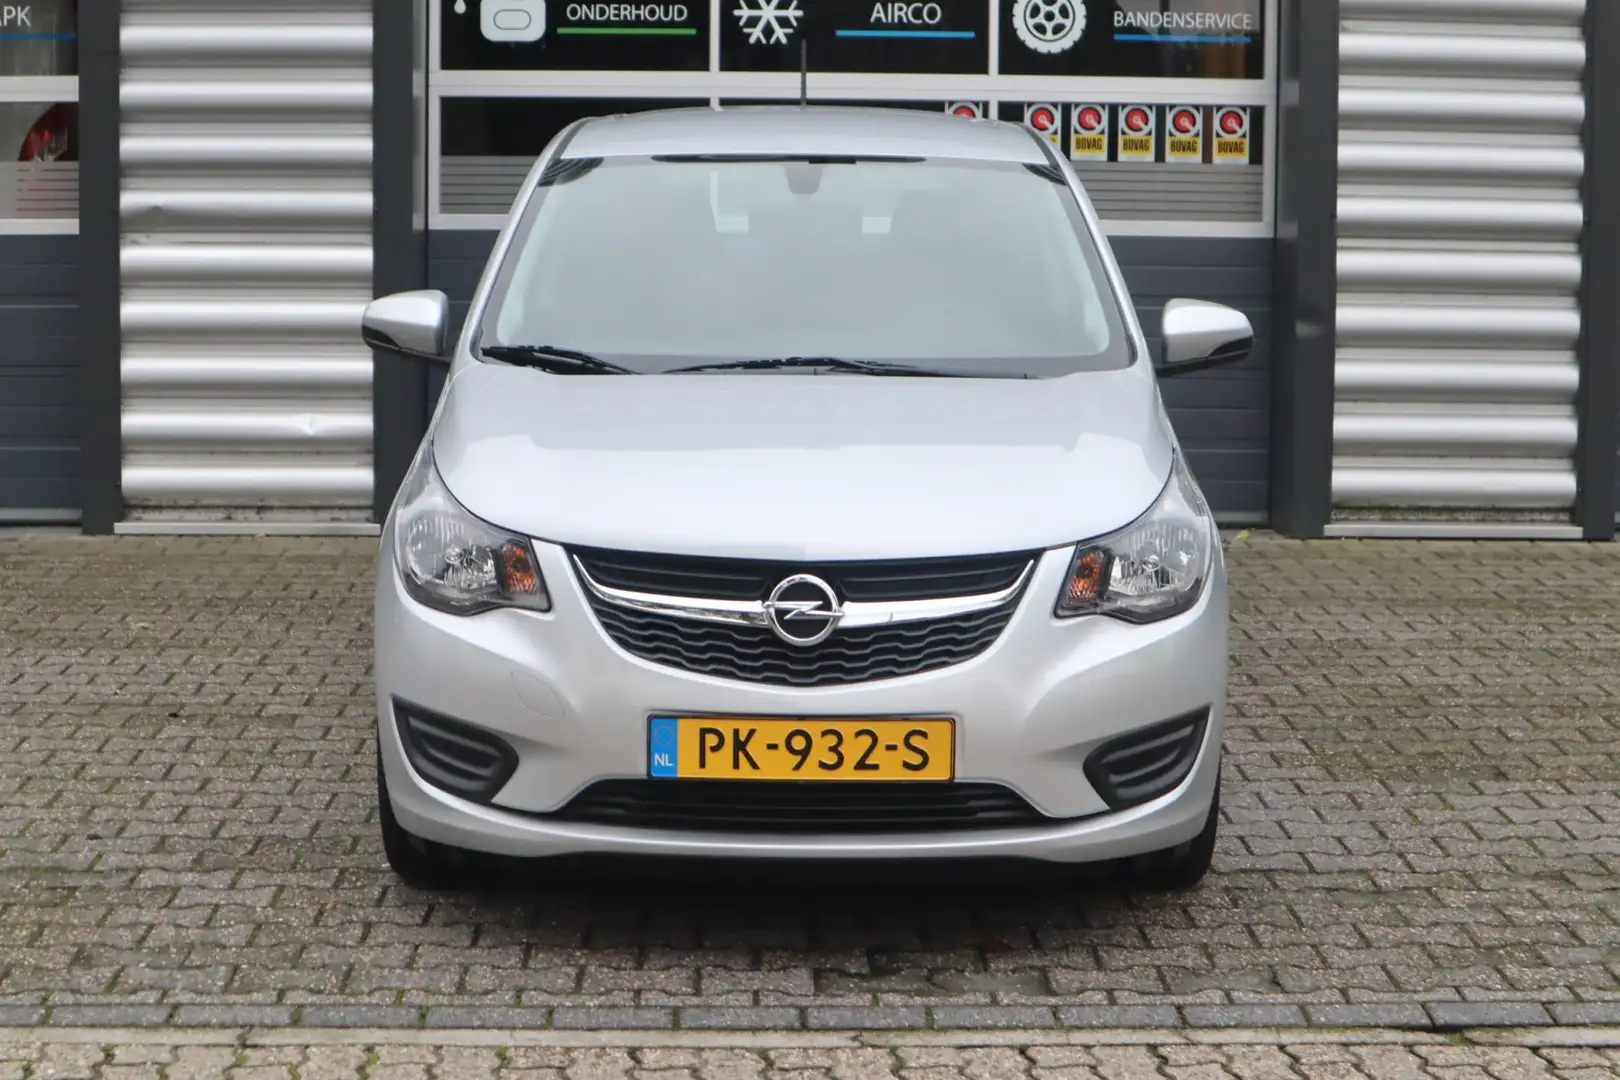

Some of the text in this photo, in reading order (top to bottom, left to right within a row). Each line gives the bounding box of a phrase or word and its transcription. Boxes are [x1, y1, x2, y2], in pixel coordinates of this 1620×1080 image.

[0, 5, 32, 27] PK
[566, 3, 688, 22] ONDERHOUD
[869, 2, 942, 25] AIRCO
[1112, 10, 1252, 30] BANDENSERVICE
[654, 753, 673, 767] NL
[699, 727, 930, 772] PK-932-S
